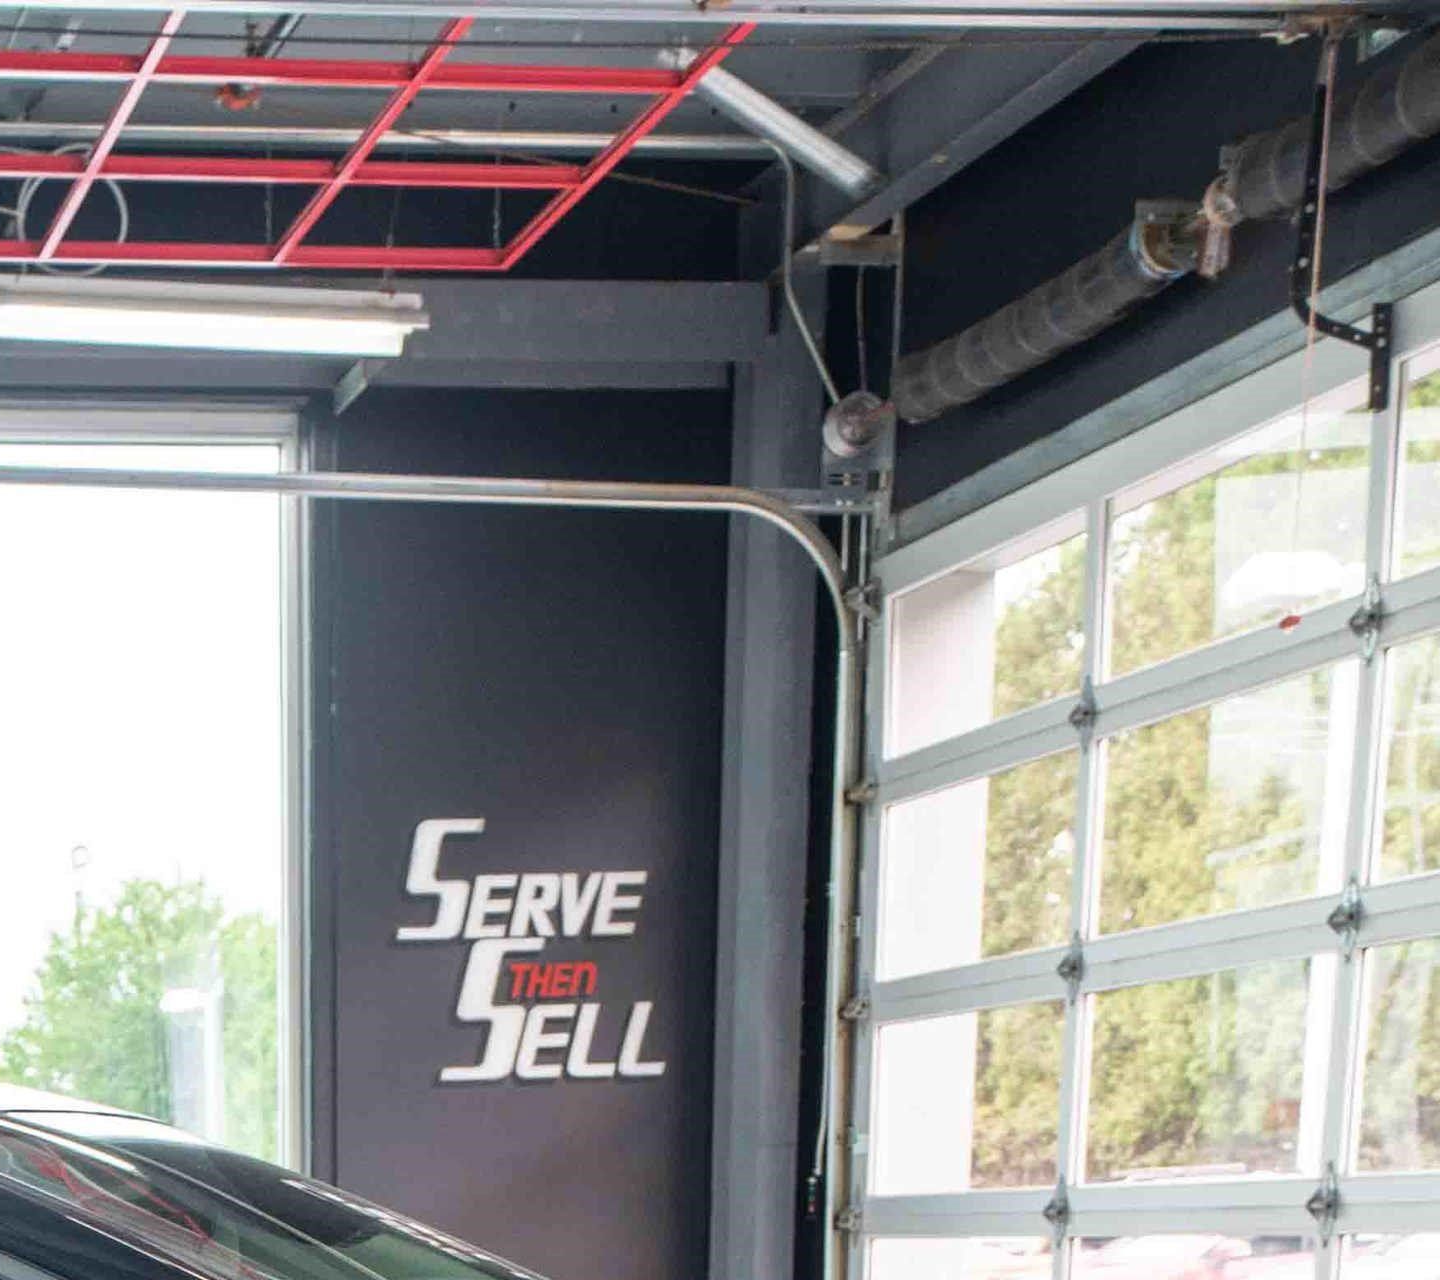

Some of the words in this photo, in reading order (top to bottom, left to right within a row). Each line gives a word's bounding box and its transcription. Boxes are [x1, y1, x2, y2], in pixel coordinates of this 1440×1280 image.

[396, 817, 649, 941] SERVE
[439, 936, 667, 1083] SELL
[510, 960, 599, 999] THEN
